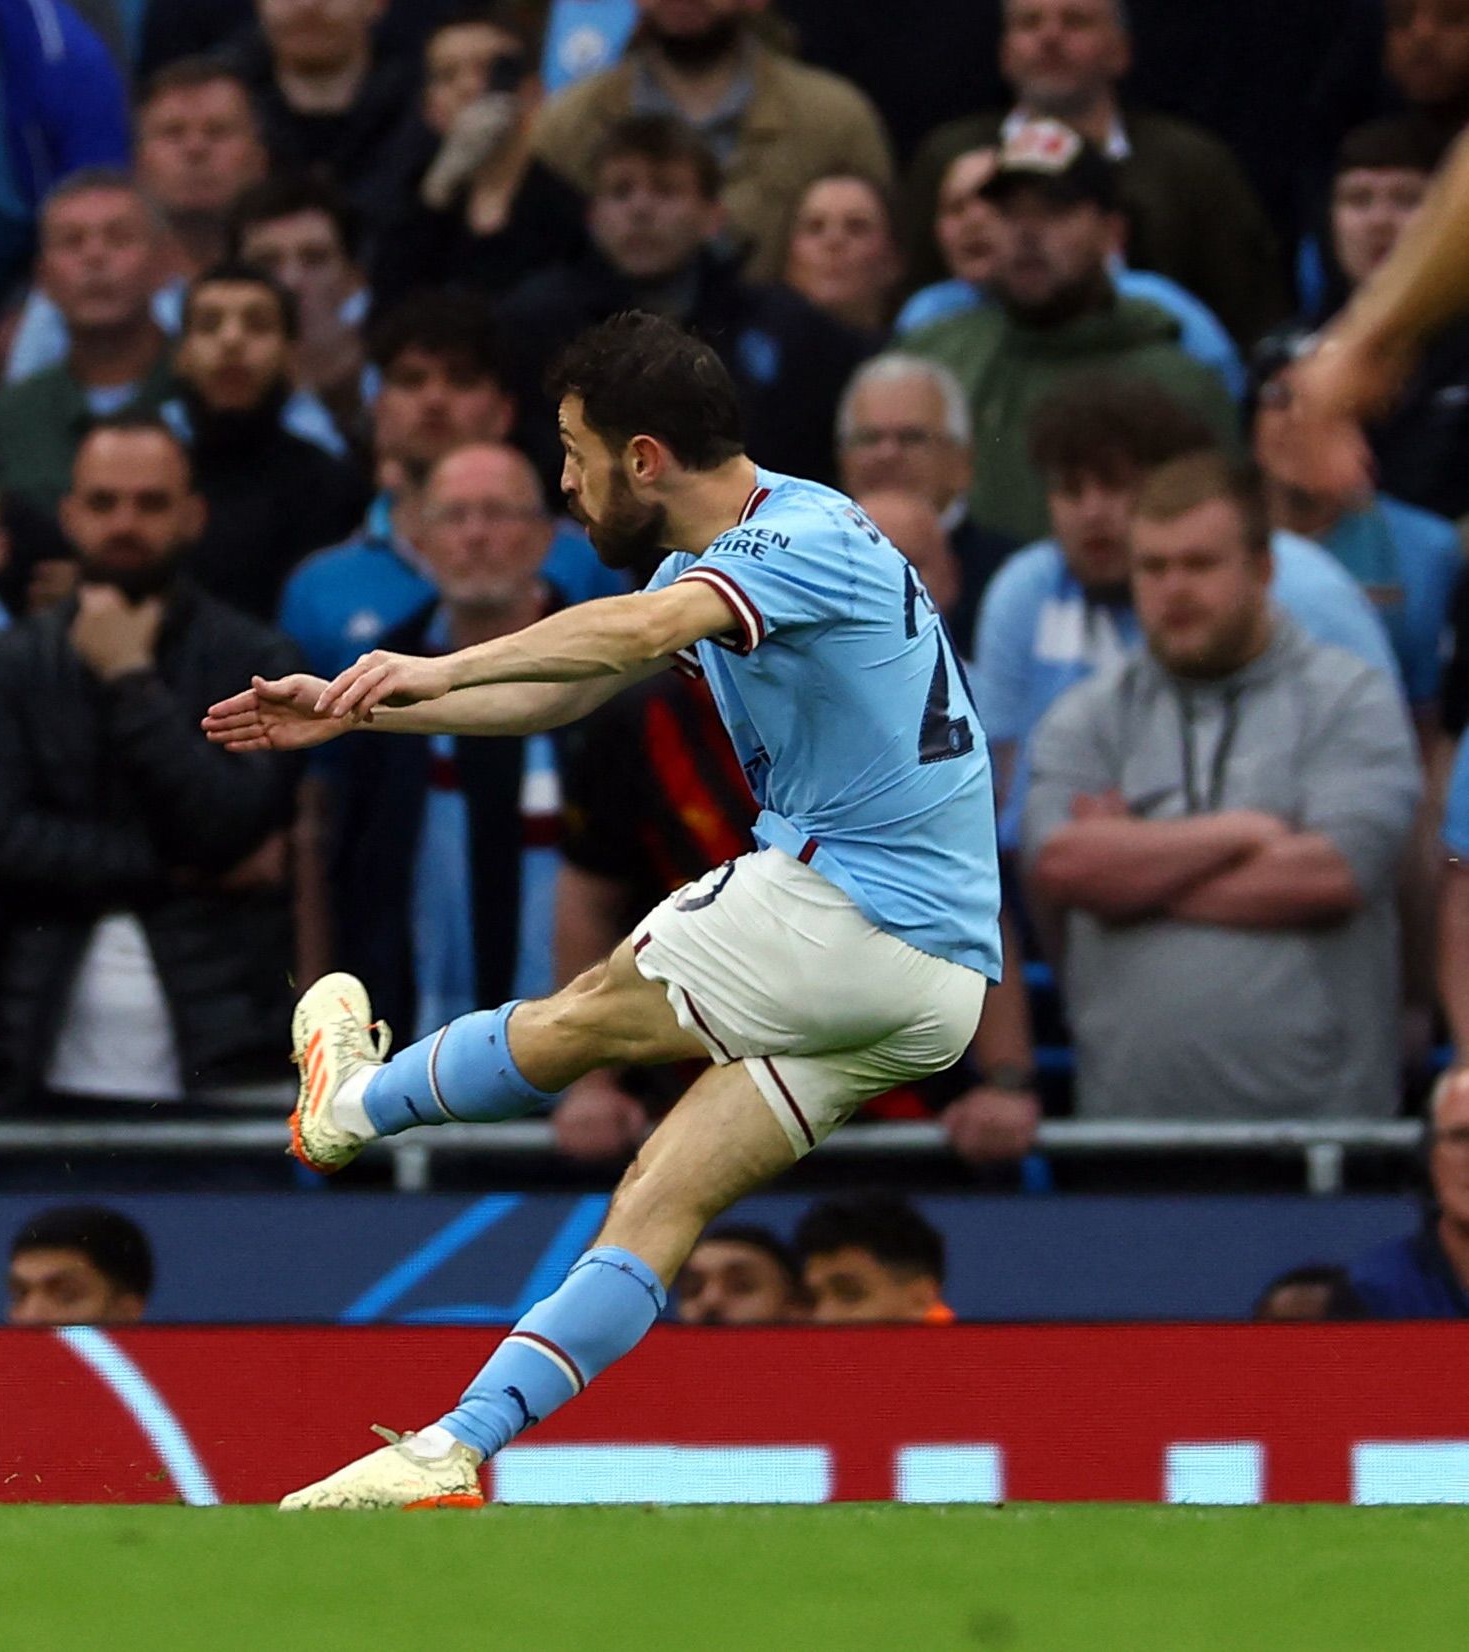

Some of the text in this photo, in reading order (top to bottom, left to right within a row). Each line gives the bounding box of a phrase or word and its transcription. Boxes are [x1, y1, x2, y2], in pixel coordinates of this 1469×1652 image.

[712, 539, 769, 562] TIRE
[718, 528, 791, 550] EXEN
[903, 563, 981, 766] 2
